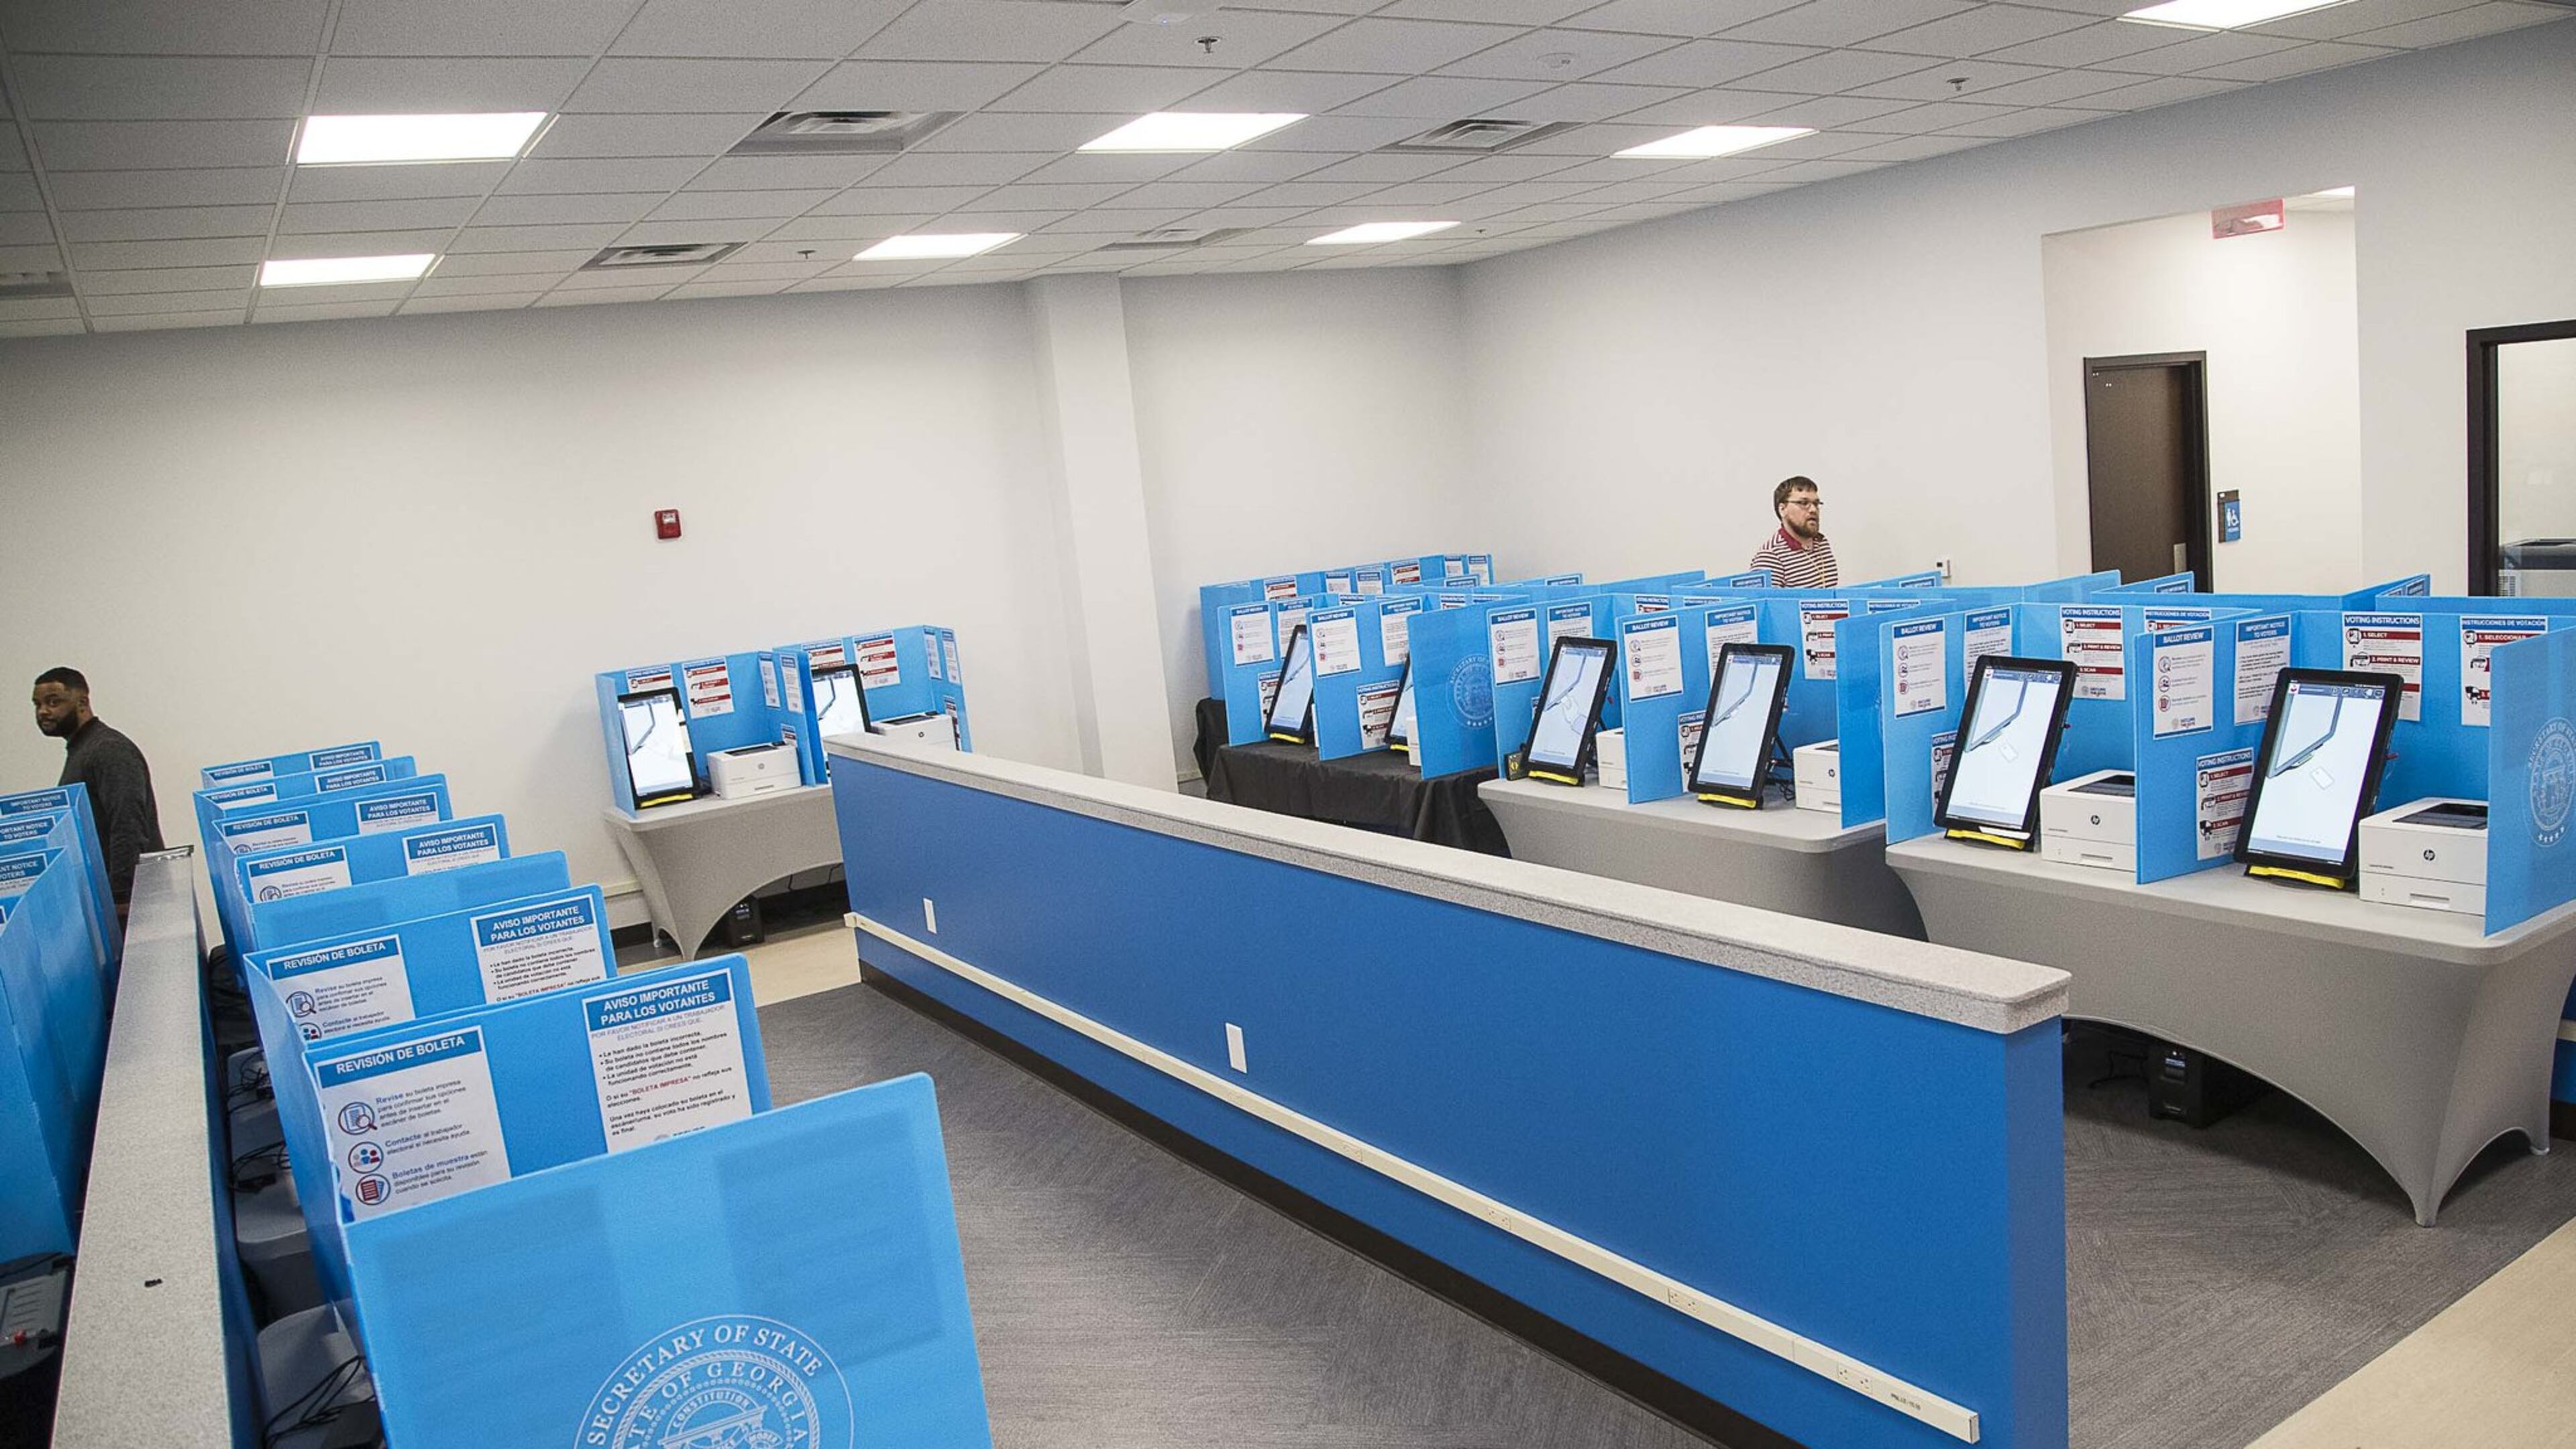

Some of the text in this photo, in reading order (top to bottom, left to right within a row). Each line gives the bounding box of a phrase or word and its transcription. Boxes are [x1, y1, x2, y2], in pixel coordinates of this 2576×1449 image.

[1632, 623, 1650, 631] BALLOT
[1901, 625, 1919, 634] BALLOT
[2246, 624, 2269, 632] IMPORTANT
[2163, 632, 2204, 643] BALLOT REVIEW
[2198, 752, 2251, 767] VOTING INSTRUCTIONS
[388, 799, 427, 808] IMPORTANTE
[399, 805, 430, 814] VOTANTES
[26, 822, 48, 830] NOTICE
[274, 816, 299, 824] BOLETA
[14, 830, 38, 838] VOTERS
[419, 831, 484, 848] AVISO IMPORTANTE
[417, 839, 488, 856] PARA LOS VOTANTES
[12, 861, 38, 869] NOTICE
[260, 858, 294, 869] REVISIÓN
[306, 851, 335, 861] BOLETA
[492, 906, 579, 930] AVISO IMPORTANTE
[491, 915, 585, 941] PARA LOS VOTANTES
[283, 942, 386, 969] REVISIÓN DE BOLETA
[604, 980, 709, 1010] AVISO IMPORTANTE
[601, 991, 715, 1024] PARA LOS VOTANTES
[645, 1046, 670, 1055] contiene
[702, 1032, 727, 1041] nombres
[336, 1036, 465, 1073] REVISIÓN DE BOLETA
[615, 1058, 649, 1069] candidatos
[616, 1068, 637, 1076] unidad
[649, 1059, 674, 1068] votación
[608, 1073, 647, 1085] funcionando
[376, 1093, 402, 1104] Revise
[385, 1134, 421, 1147] Contacte
[392, 1166, 422, 1179] Boletas
[437, 1155, 468, 1167] muestra
[587, 1325, 823, 1446] SECRETARY OF STATE
[661, 1362, 809, 1442] OF GEORGIA
[672, 1392, 751, 1428] CONSTITUTION
